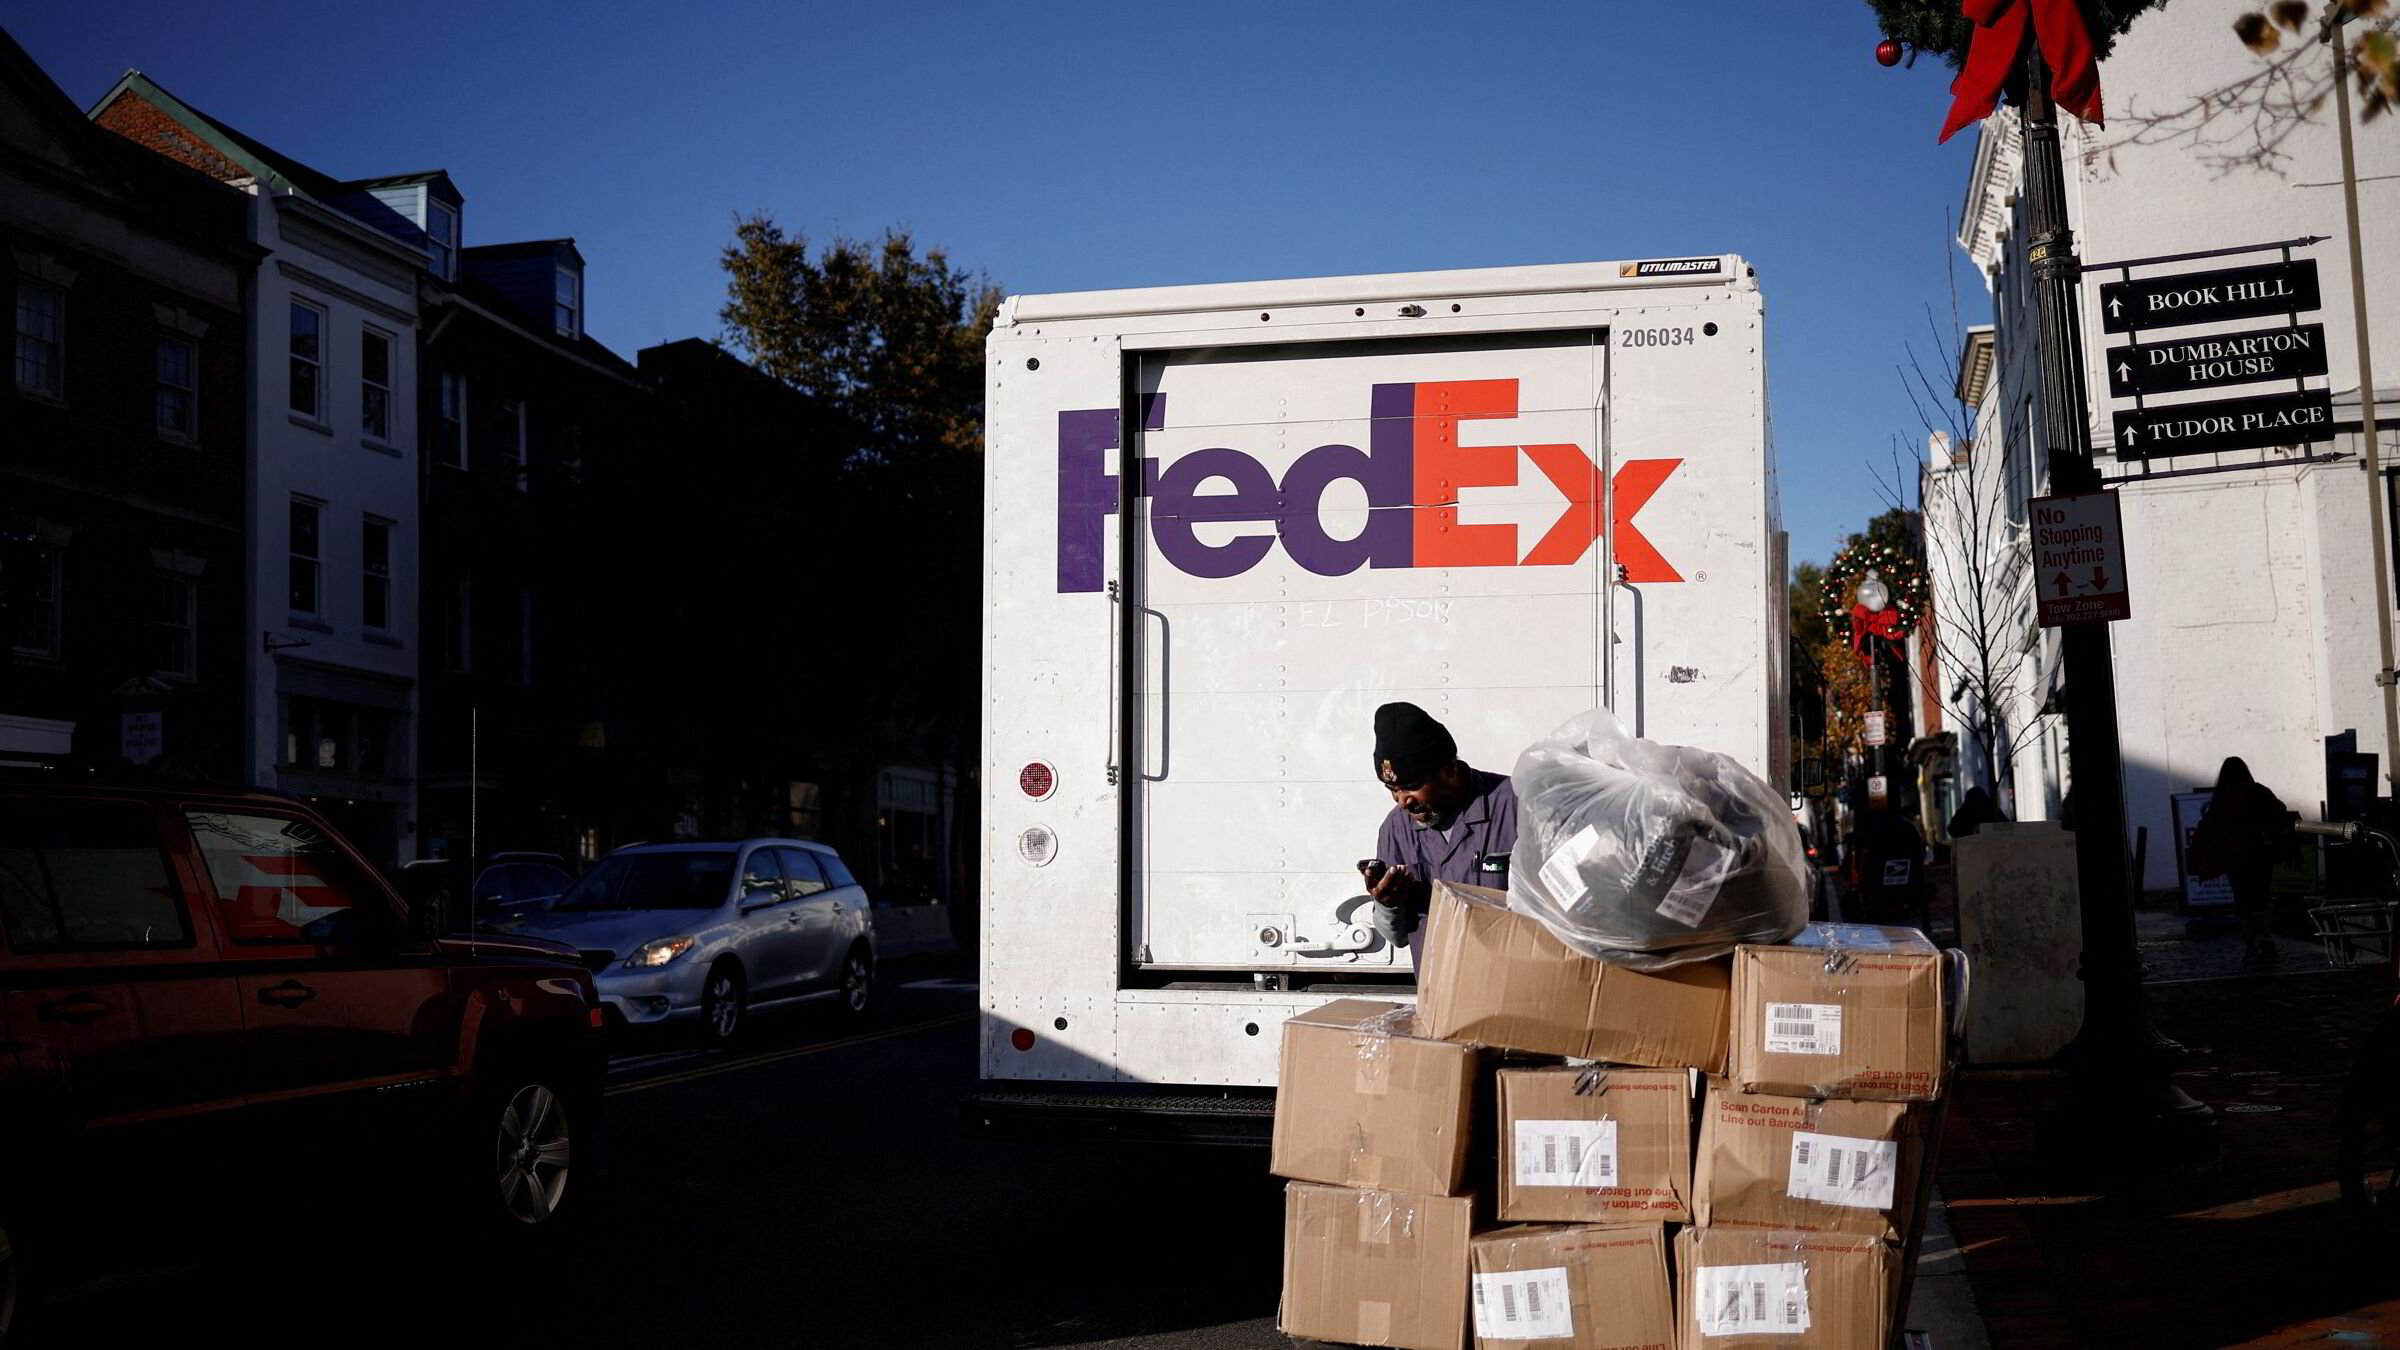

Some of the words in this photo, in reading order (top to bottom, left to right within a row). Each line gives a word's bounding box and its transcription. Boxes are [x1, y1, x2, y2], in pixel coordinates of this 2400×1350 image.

[1639, 260, 1718, 273] UTILIMASTER
[2147, 286, 2219, 312] BOOK
[2226, 279, 2294, 302] HILL
[1622, 327, 1695, 347] 206034
[2149, 331, 2311, 366] DUMBARTON
[2188, 356, 2275, 382] HOUSE
[2148, 415, 2235, 441] TUDOR
[2242, 406, 2325, 431] PLACE
[1057, 378, 1686, 594] FedEx
[2037, 508, 2065, 526] No
[2039, 524, 2103, 547] Stopping
[2042, 547, 2104, 570] Anytime
[1299, 599, 1344, 628] EL
[2047, 603, 2073, 615] Tow
[2074, 600, 2104, 612] Zone
[1884, 1072, 1903, 1080] out
[1721, 1101, 1749, 1113] Scan
[1752, 1104, 1790, 1116] Carton
[1721, 1114, 1745, 1126] Line
[1747, 1117, 1765, 1127] out
[1768, 1117, 1816, 1131] Barcode
[1634, 1188, 1652, 1198] out
[1612, 1200, 1650, 1211] Carton
[1652, 1201, 1679, 1211] Scan
[1825, 1245, 1853, 1253] Bottom
